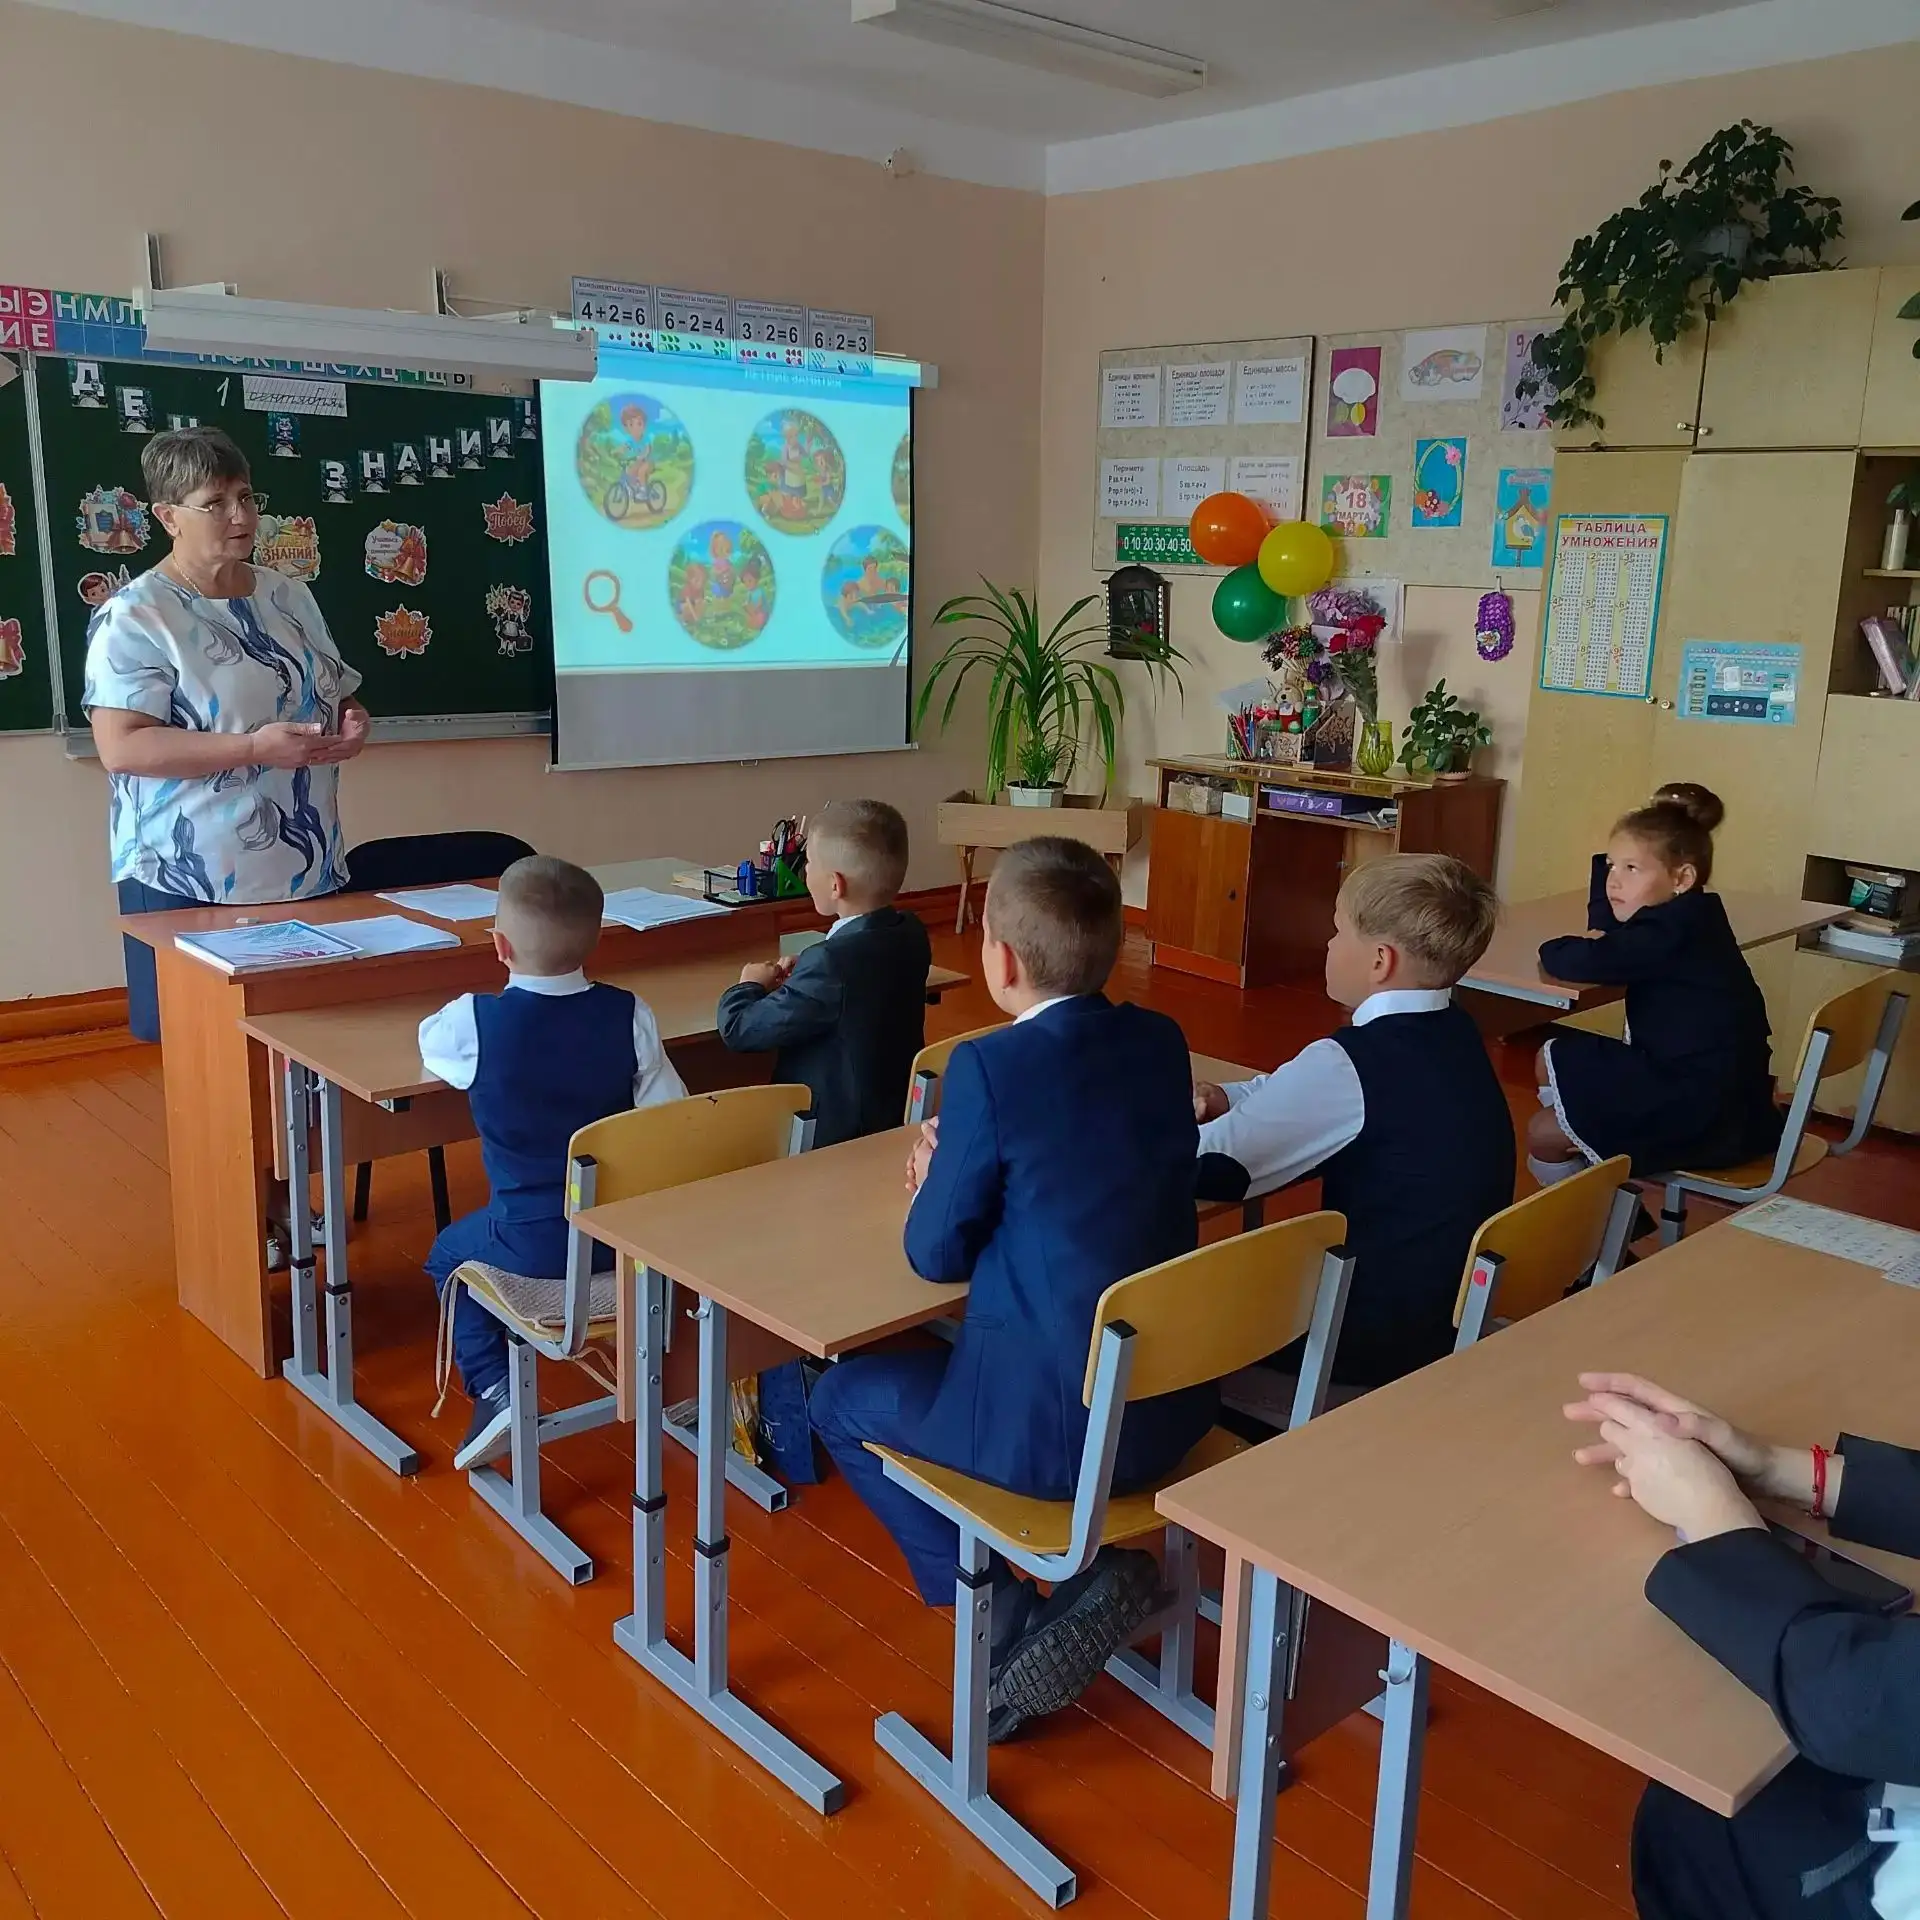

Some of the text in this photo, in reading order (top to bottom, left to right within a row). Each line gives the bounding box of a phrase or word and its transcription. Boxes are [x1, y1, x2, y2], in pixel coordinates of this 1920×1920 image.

[217, 377, 230, 407] 1
[1346, 492, 1367, 509] 18
[1338, 511, 1371, 521] МАРТА
[1576, 522, 1647, 535] ТАБЛИЦА
[1561, 536, 1658, 548] УМНОЖЕНИЯ
[262, 547, 317, 561] ЗНАНИЙ!
